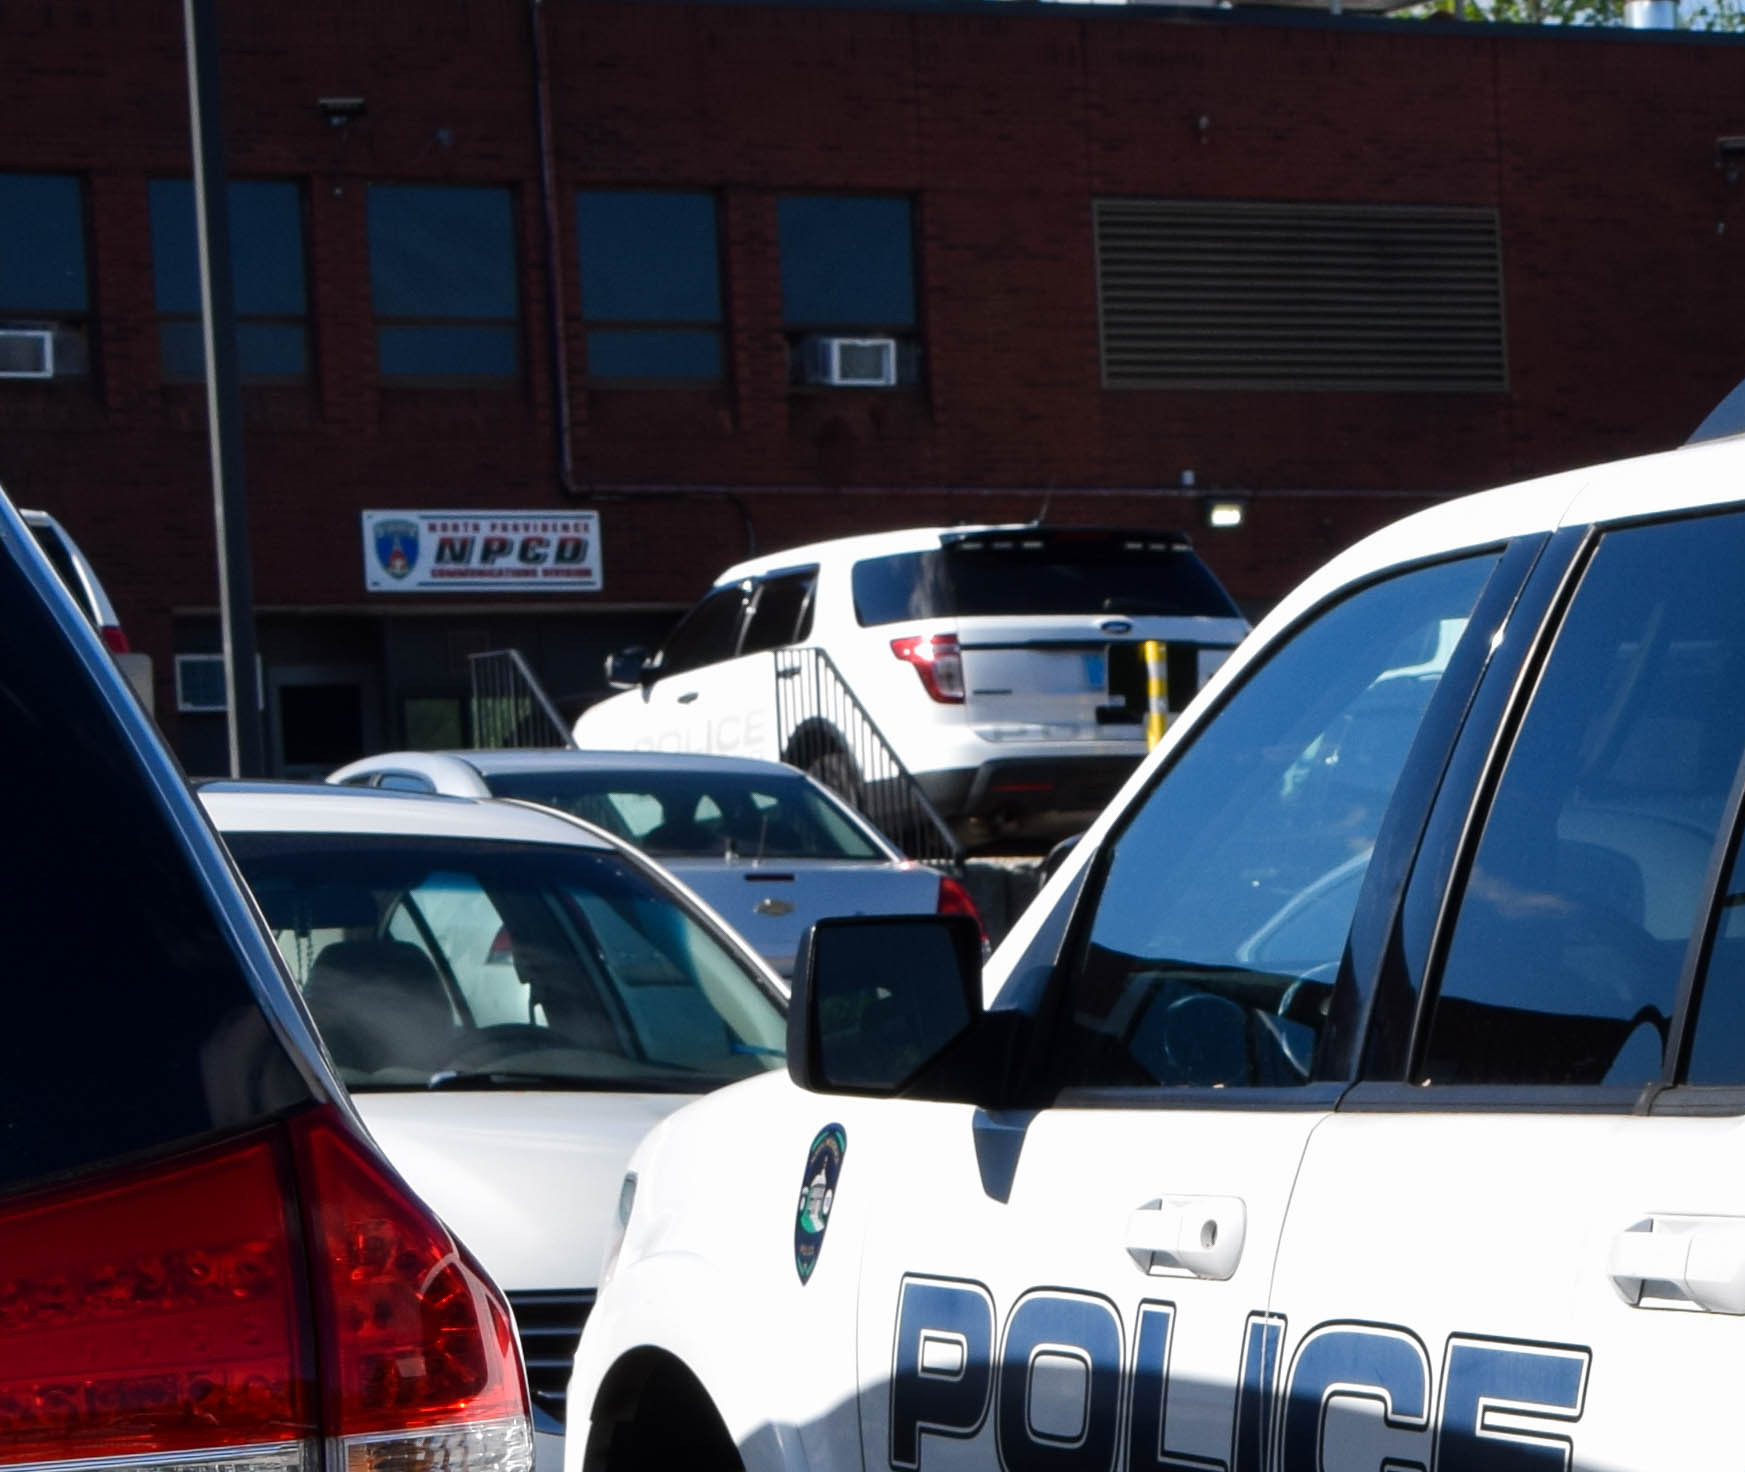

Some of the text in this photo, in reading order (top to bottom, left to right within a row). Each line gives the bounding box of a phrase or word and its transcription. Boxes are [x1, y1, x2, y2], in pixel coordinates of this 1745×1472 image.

[428, 522, 480, 533] NORTH
[490, 522, 590, 533] PROVIDENCE
[434, 537, 589, 565] NPCD
